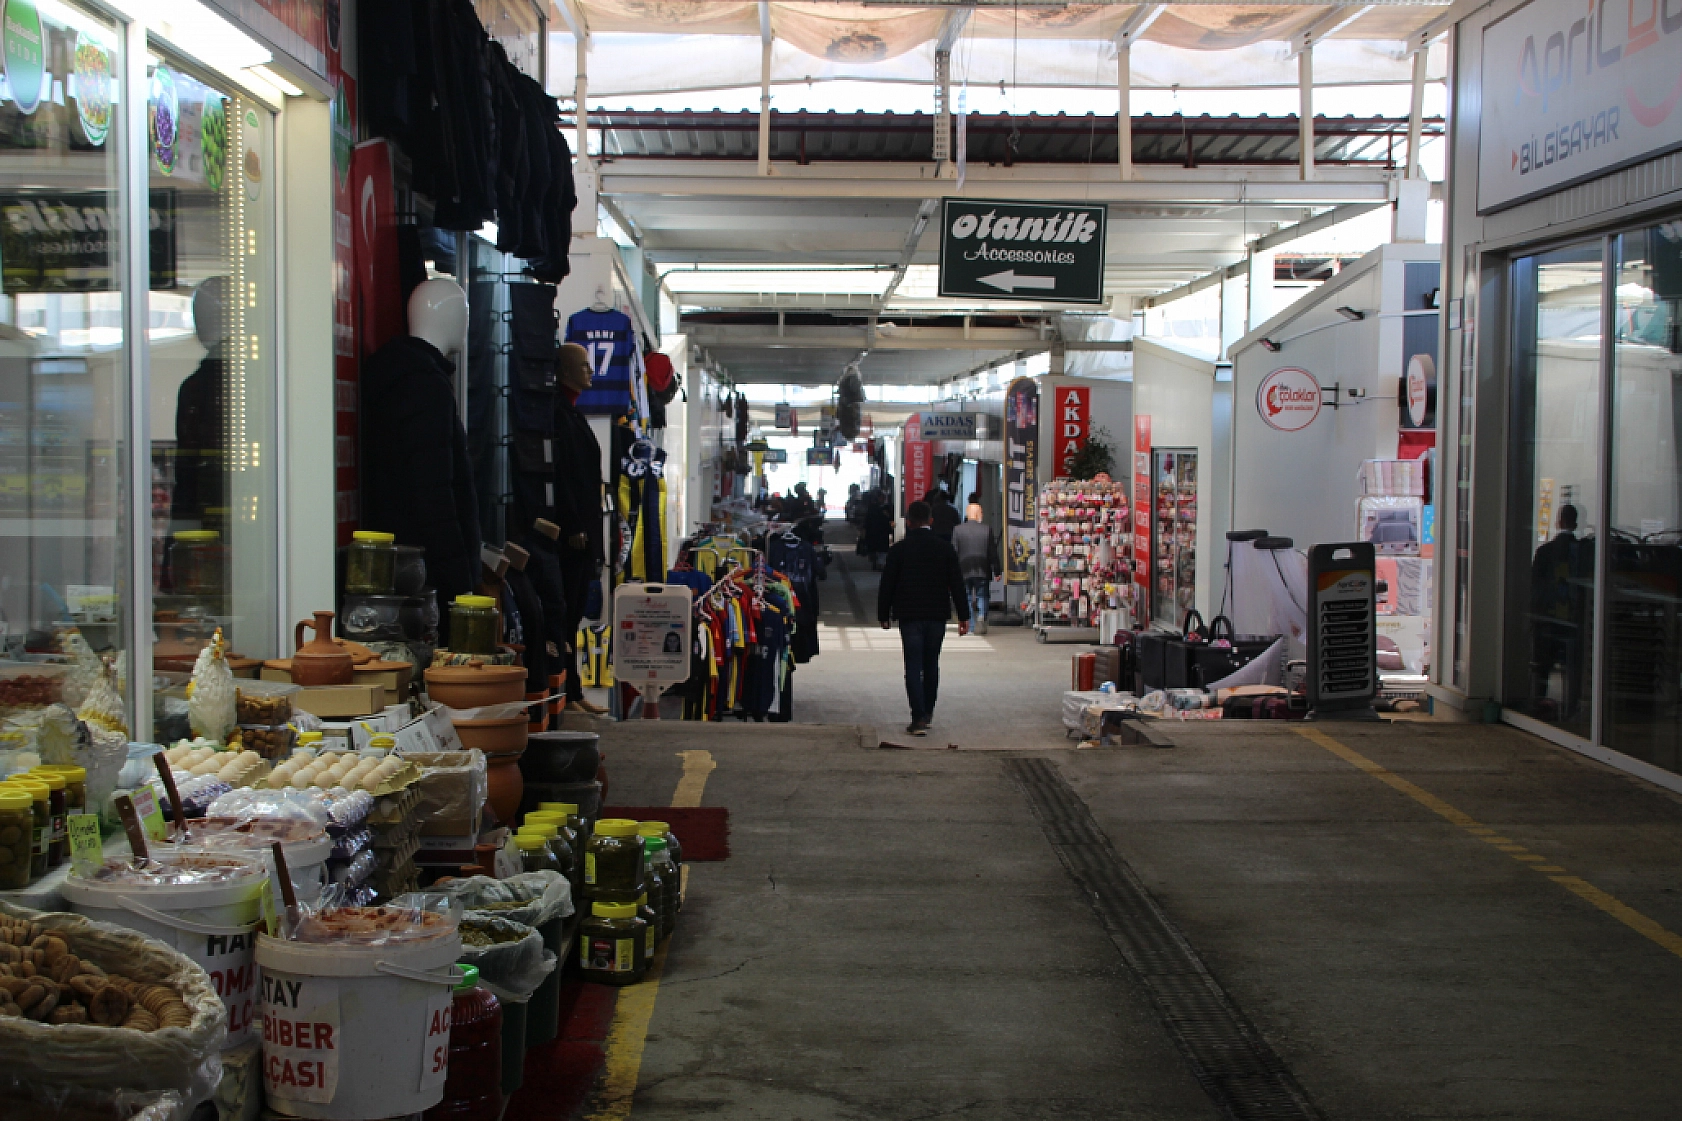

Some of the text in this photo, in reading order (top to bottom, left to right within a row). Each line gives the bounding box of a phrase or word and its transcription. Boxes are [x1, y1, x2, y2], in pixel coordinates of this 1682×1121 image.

[1519, 106, 1620, 176] BİLGİSAYAR
[963, 241, 1075, 264] Accessories
[587, 341, 615, 377] 17
[207, 932, 255, 957] HA
[209, 962, 258, 998] OMA
[262, 974, 302, 1009] TAY
[228, 999, 254, 1034] LÇ
[264, 1010, 335, 1050] BİBER
[263, 1049, 325, 1089] LÇASI
